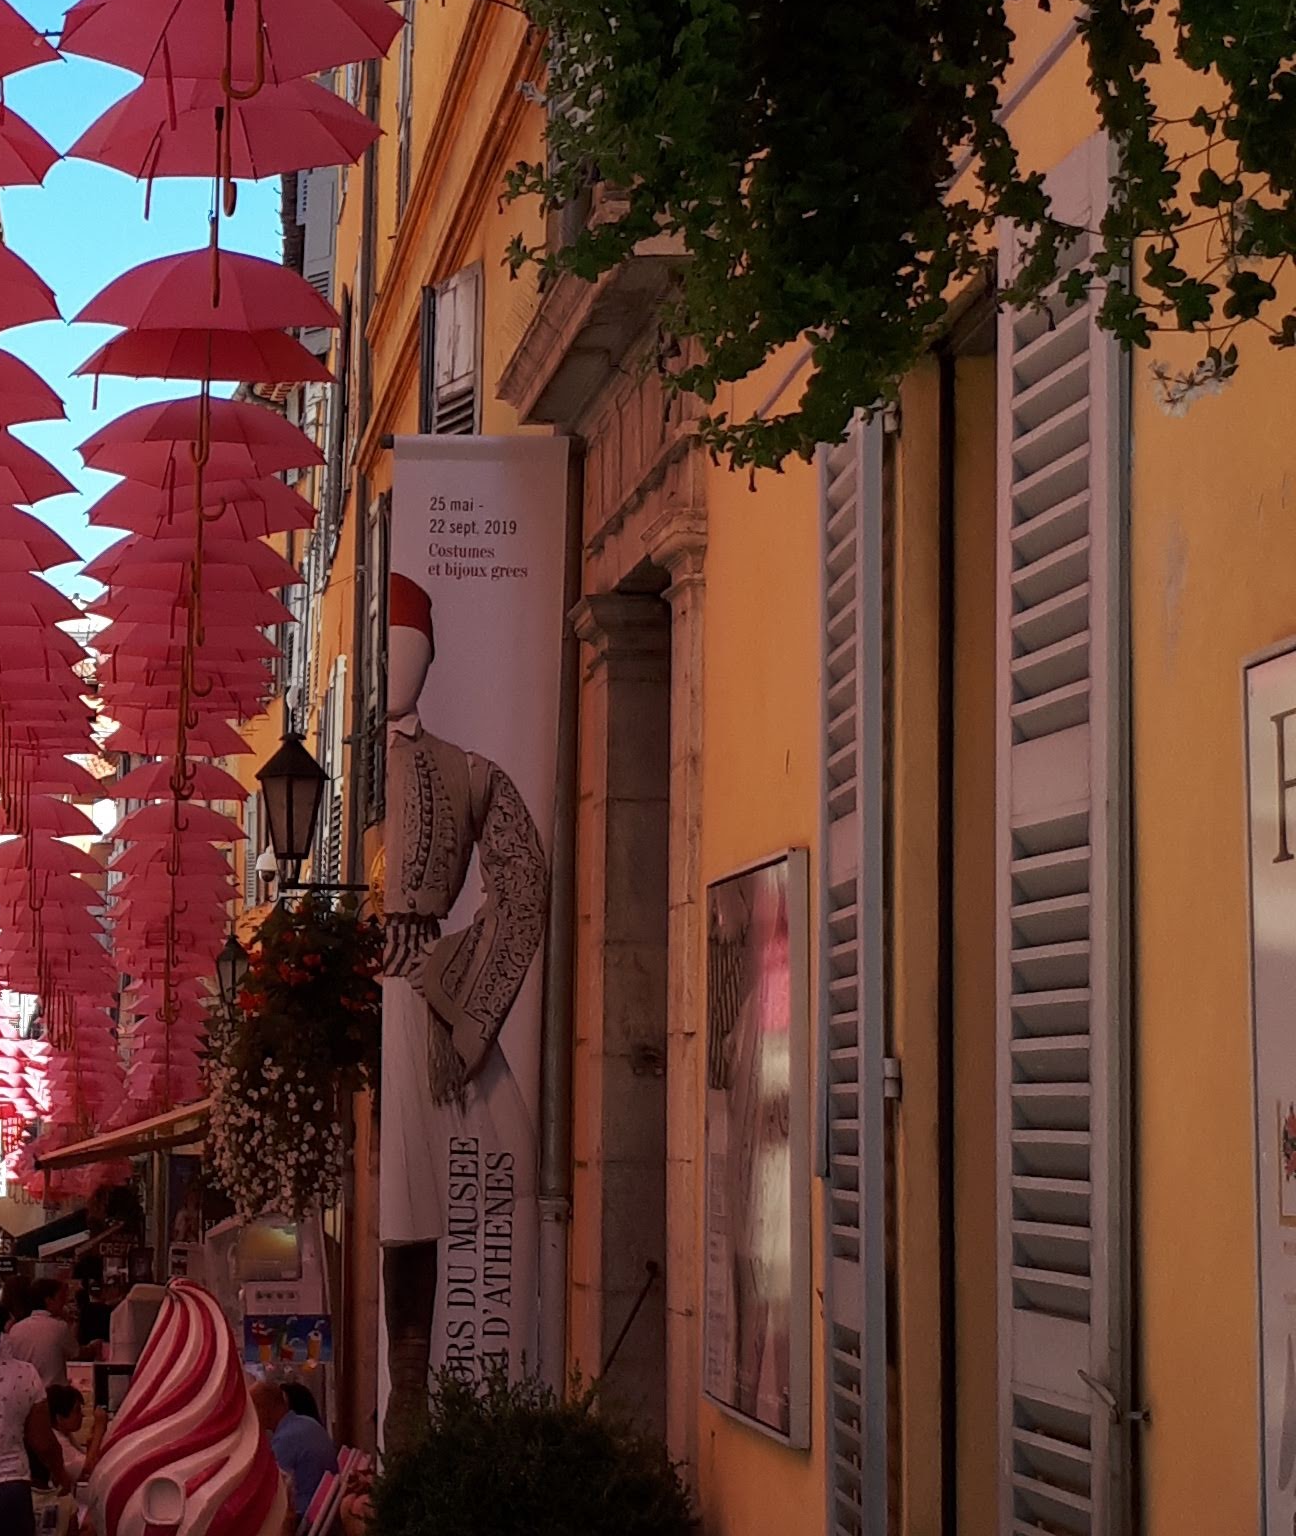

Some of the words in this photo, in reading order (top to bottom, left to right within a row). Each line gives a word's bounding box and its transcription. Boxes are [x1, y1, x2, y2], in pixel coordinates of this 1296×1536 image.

[429, 496, 446, 511] 25
[450, 497, 474, 512] mai
[429, 519, 445, 534] 22
[449, 520, 479, 537] sept.
[484, 520, 517, 535] 2019
[428, 542, 495, 559] Costumes
[428, 563, 441, 576] et
[445, 562, 488, 580] bijoux
[491, 566, 528, 581] grecs
[448, 1136, 480, 1254] MUSEE
[482, 1151, 515, 1340] D'ATHENES
[447, 1265, 478, 1309] DU
